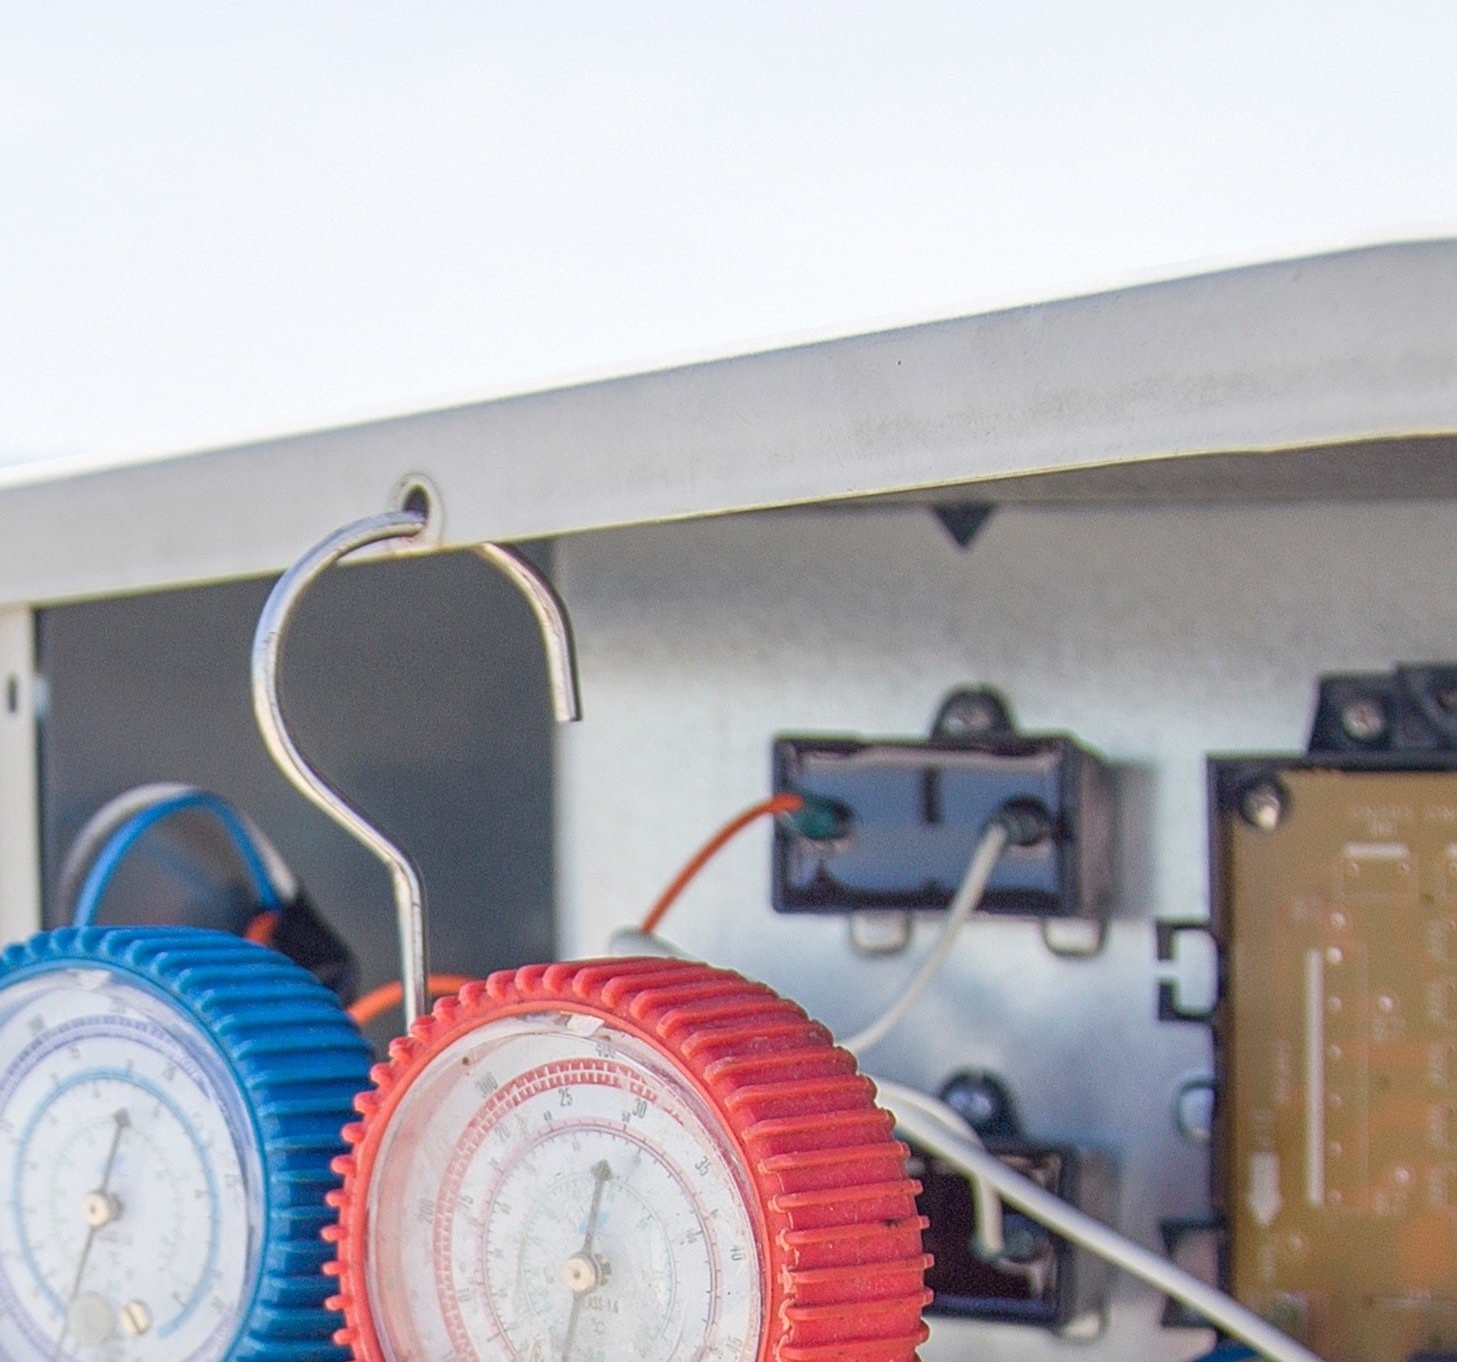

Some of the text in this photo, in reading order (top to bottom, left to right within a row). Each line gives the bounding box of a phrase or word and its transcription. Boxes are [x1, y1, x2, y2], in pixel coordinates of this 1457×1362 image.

[558, 1087, 574, 1107] 25
[632, 1097, 648, 1119] 30
[694, 1155, 711, 1178] 35
[729, 1244, 746, 1261] 40
